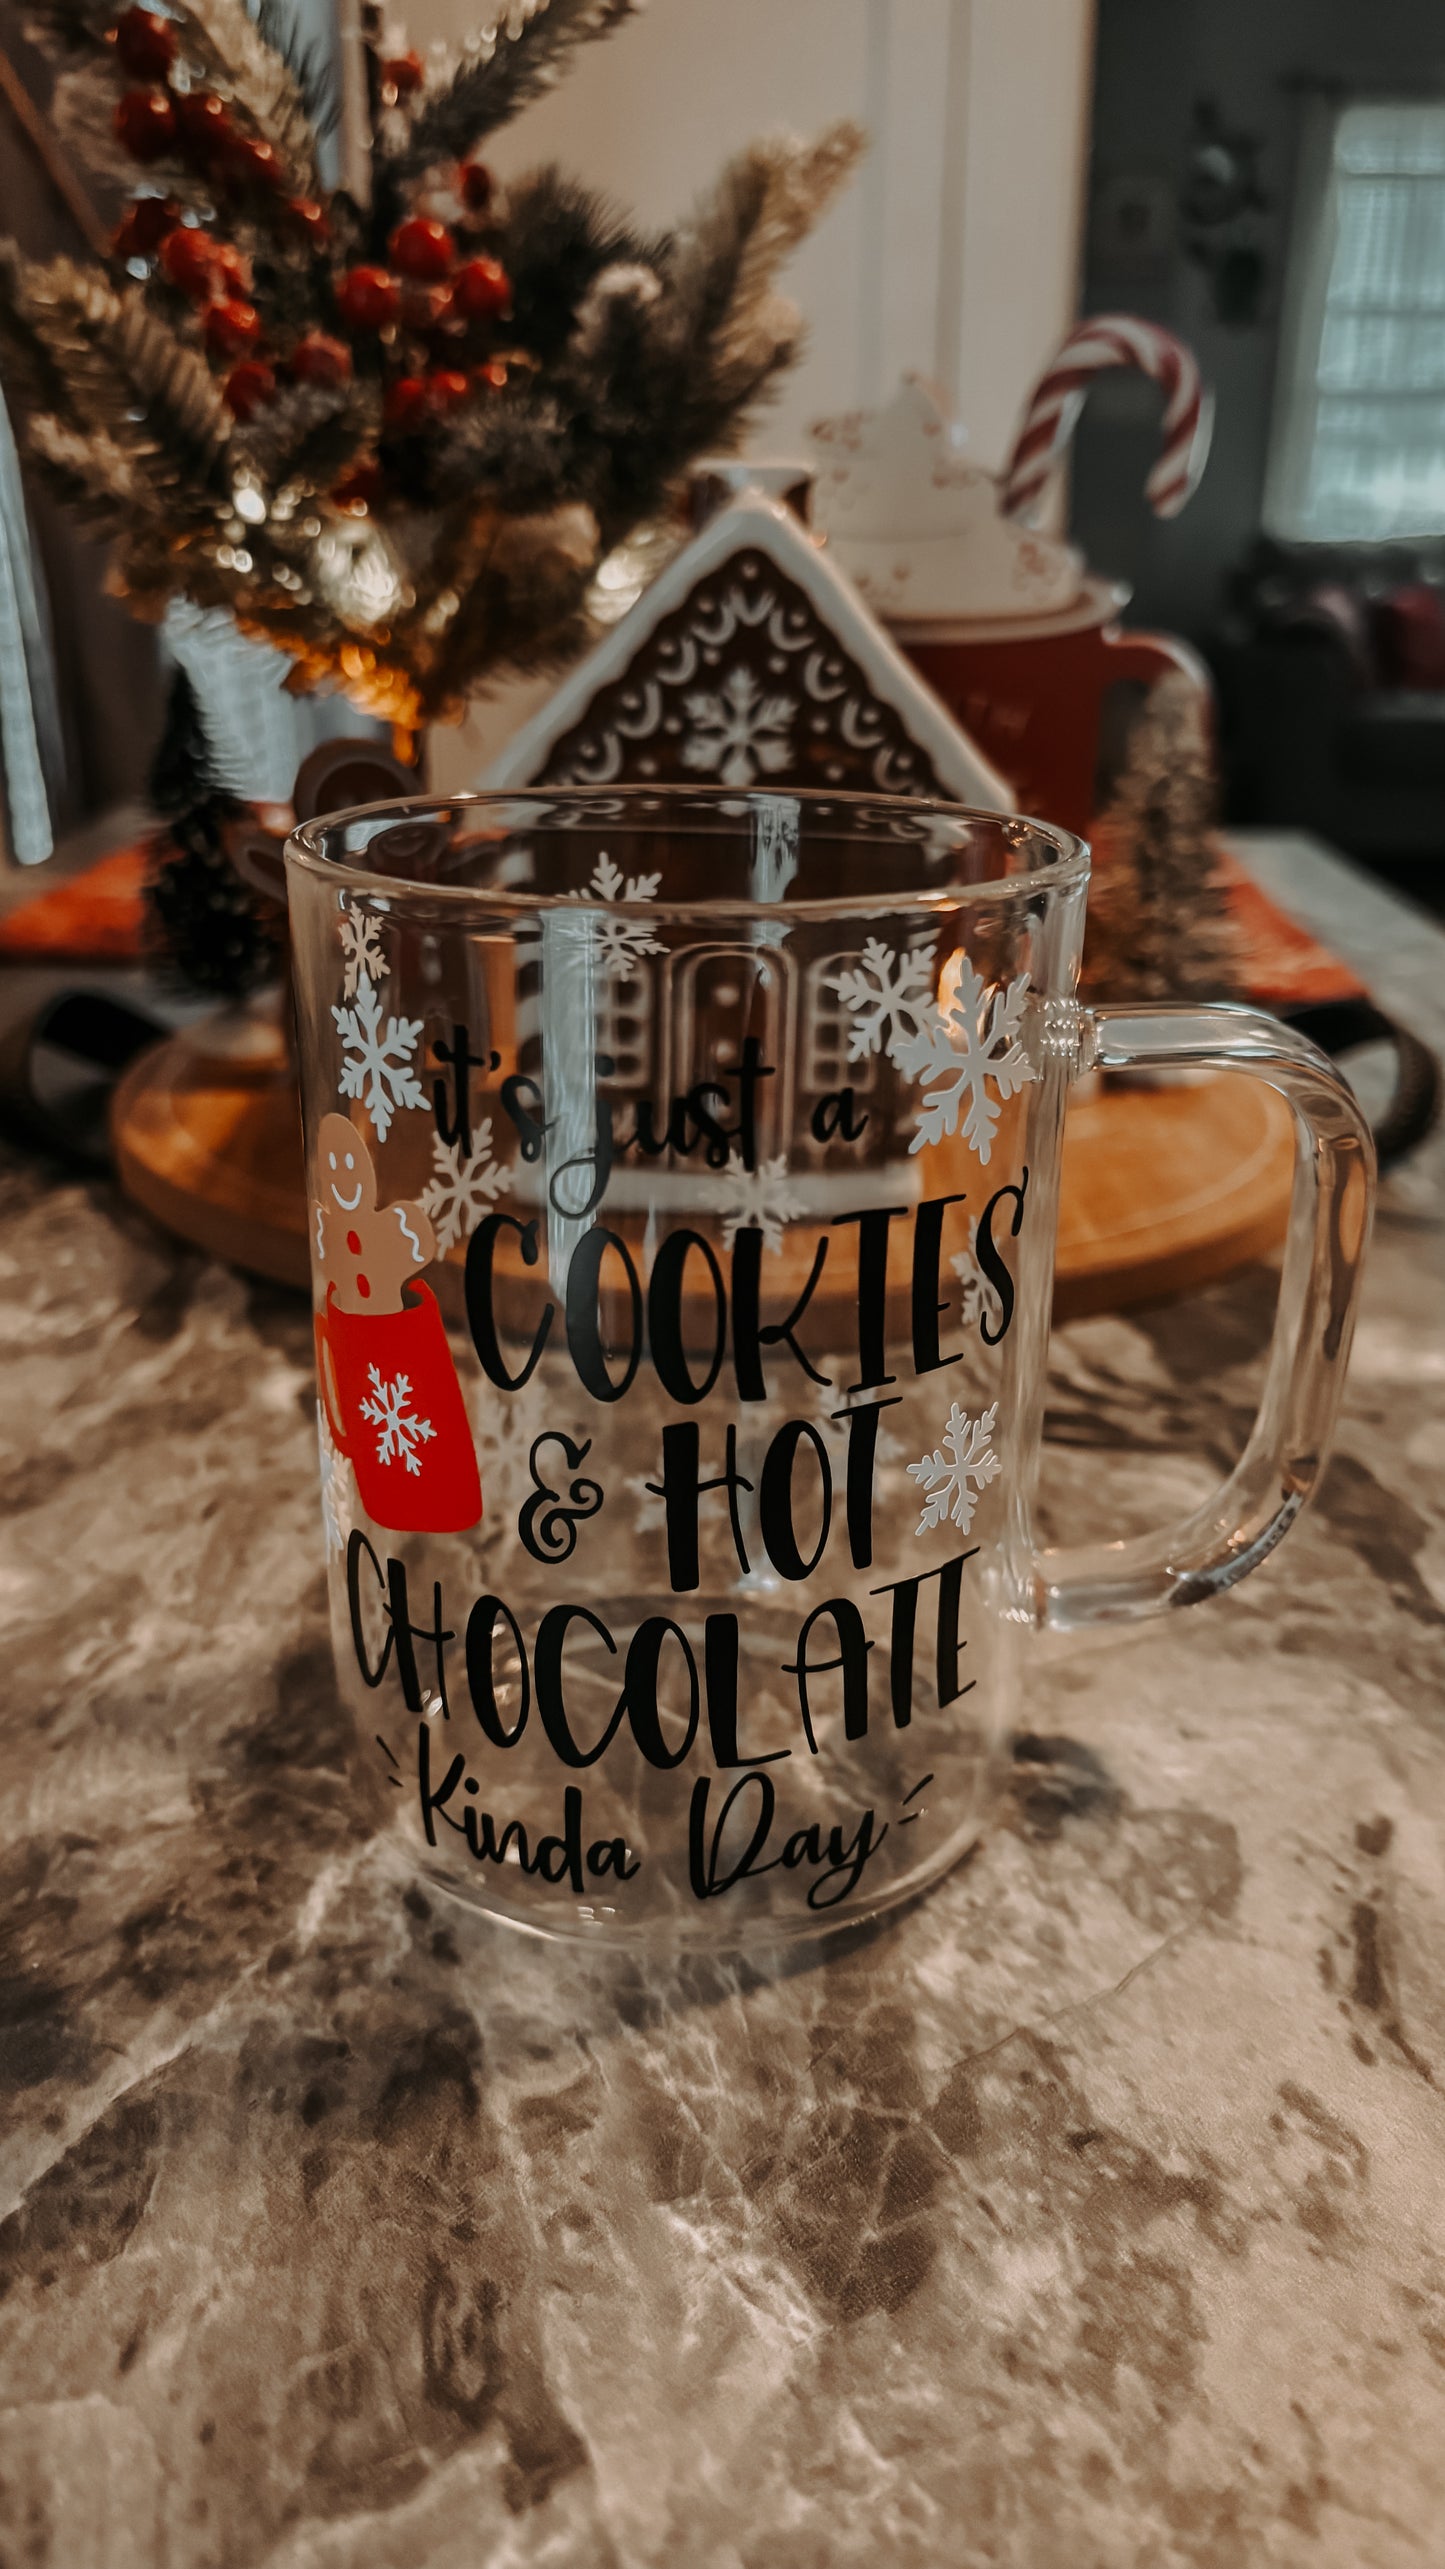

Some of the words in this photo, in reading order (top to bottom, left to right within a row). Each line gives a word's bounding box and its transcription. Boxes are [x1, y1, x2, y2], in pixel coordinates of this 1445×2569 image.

[433, 1024, 557, 1162] it's
[550, 1037, 776, 1220] just
[811, 1087, 869, 1143] a
[465, 1166, 1029, 1402] COOKIES
[518, 1431, 604, 1565] &
[646, 1396, 903, 1593] HOT
[347, 1529, 981, 1769] CHOCOLATE
[418, 1722, 641, 1893] Kinda
[689, 1771, 889, 1909] Day
